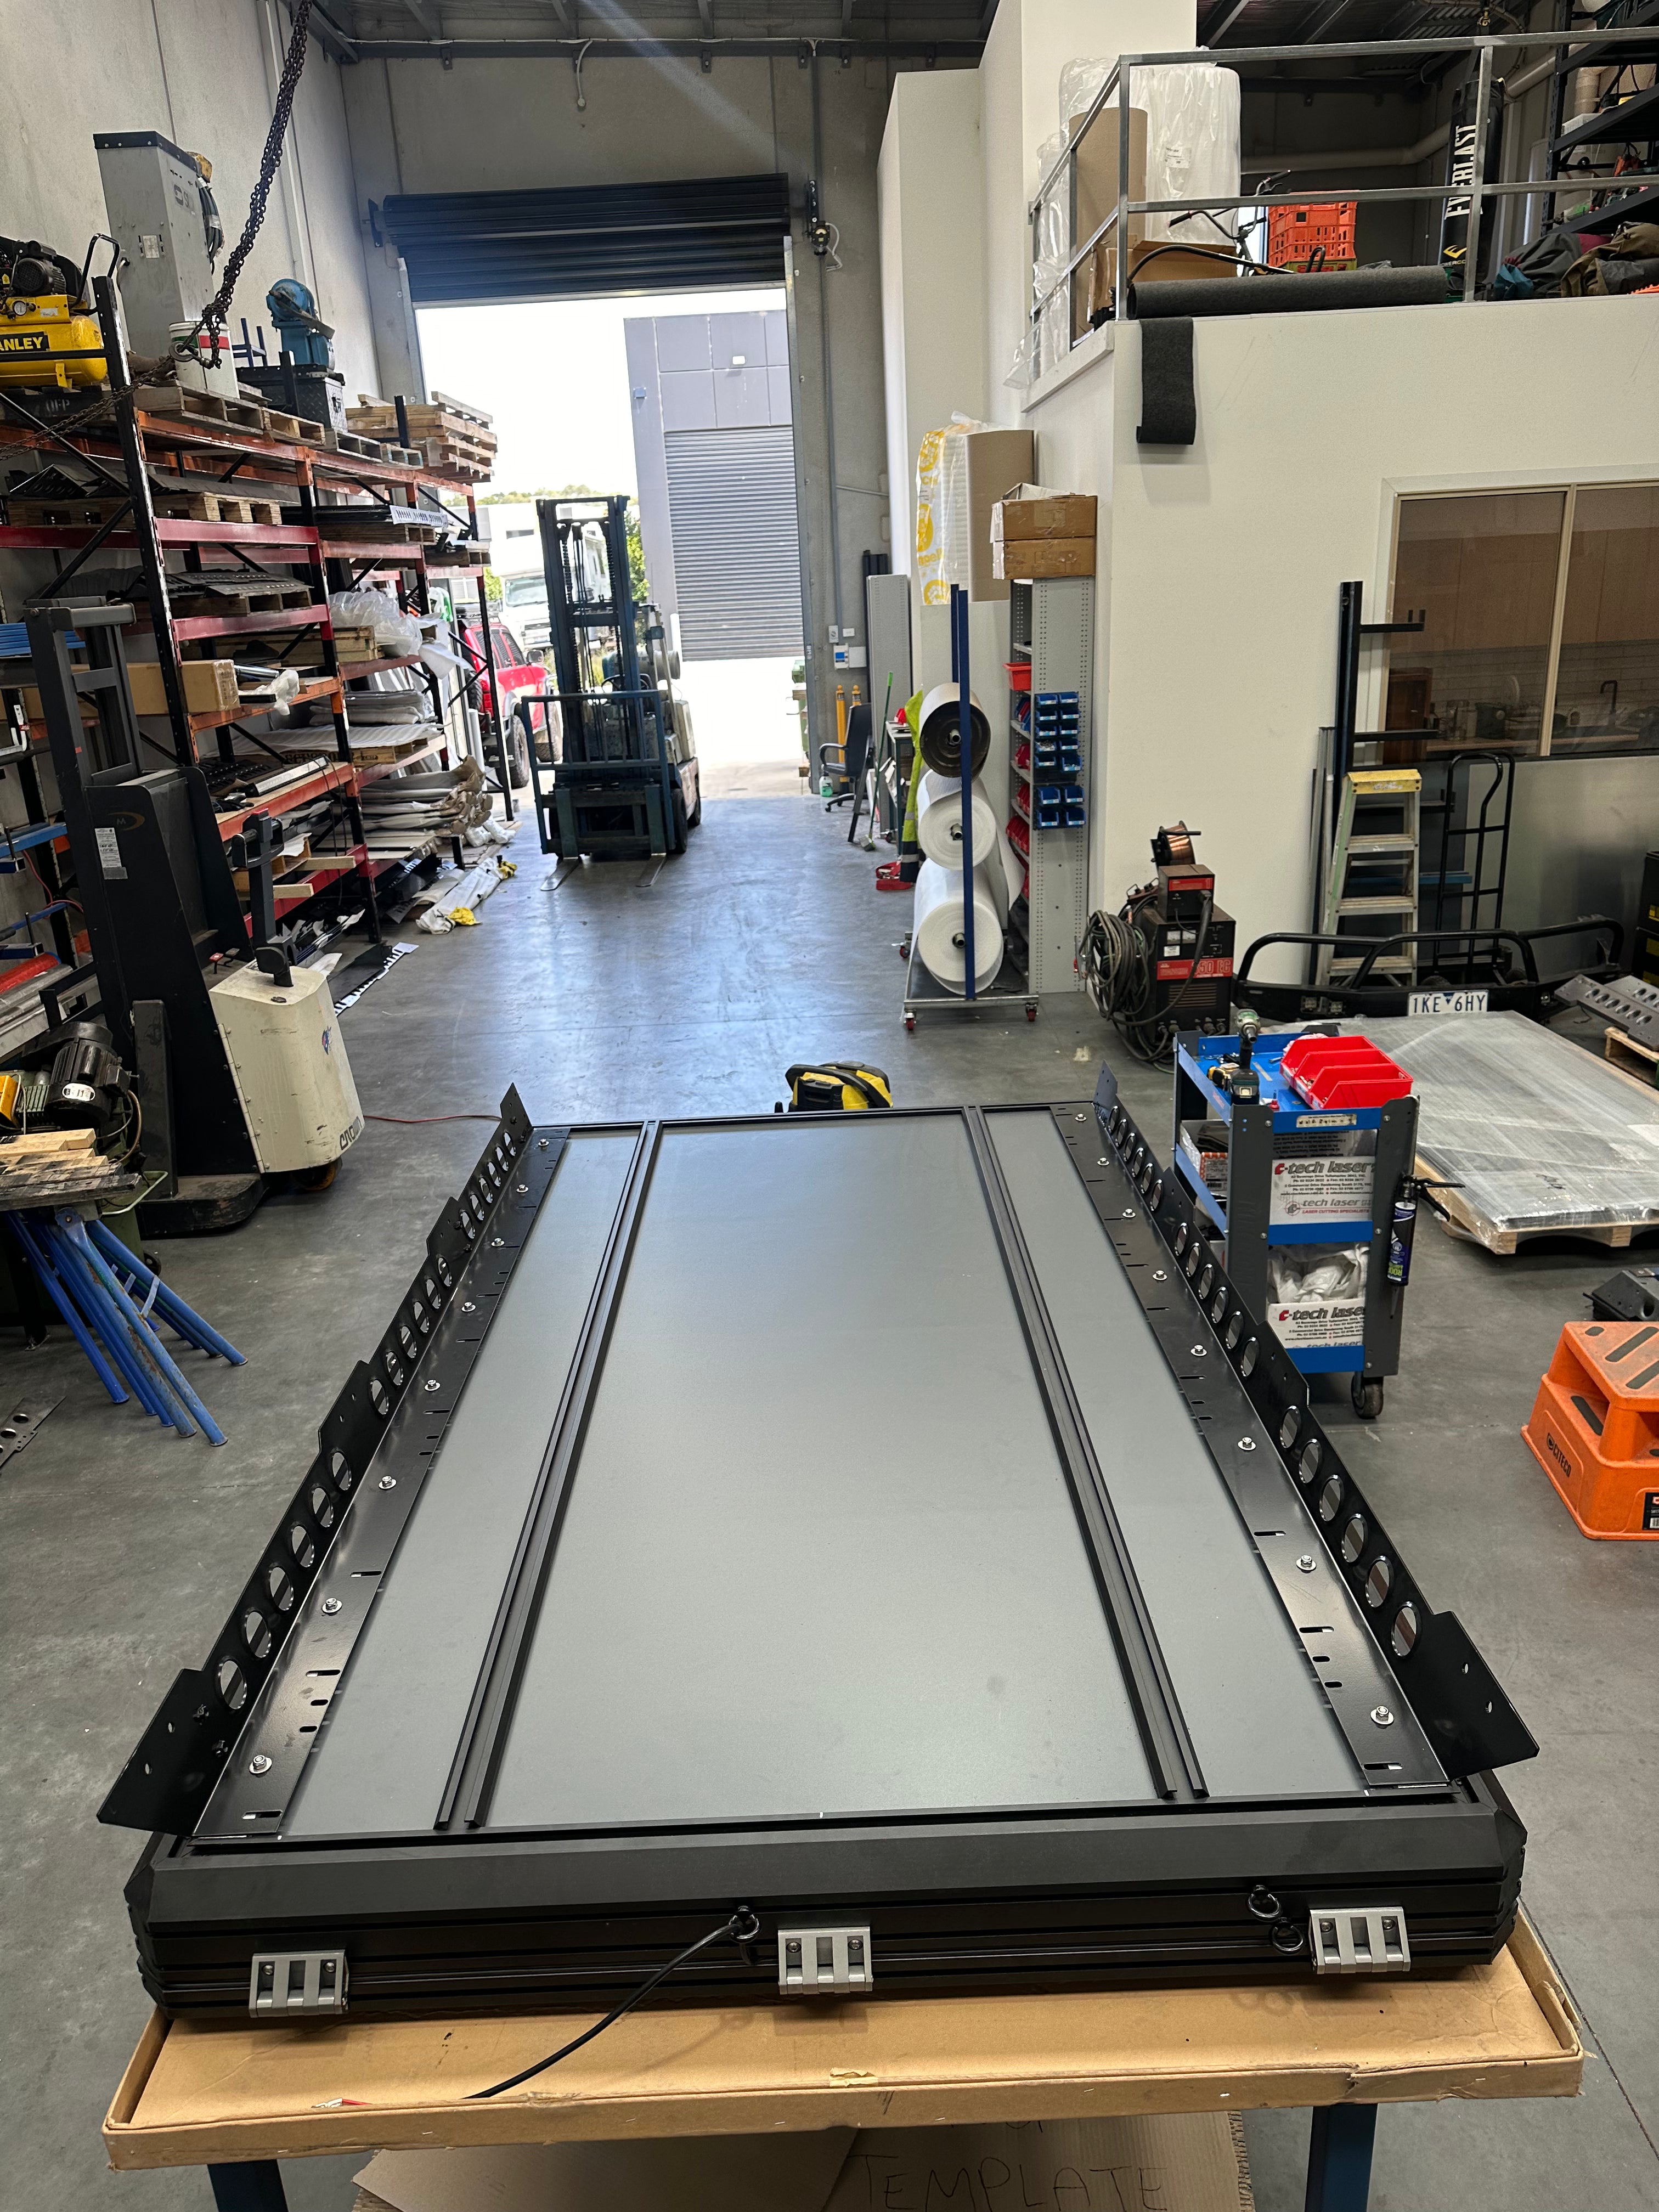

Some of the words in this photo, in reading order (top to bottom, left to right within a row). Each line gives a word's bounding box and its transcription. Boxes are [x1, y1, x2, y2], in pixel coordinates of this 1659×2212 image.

[1414, 997, 1441, 1013] 1KE
[1454, 995, 1486, 1011] 6HY
[1327, 1161, 1371, 1173] laser
[846, 2154, 1168, 2212] TEMPLATE
